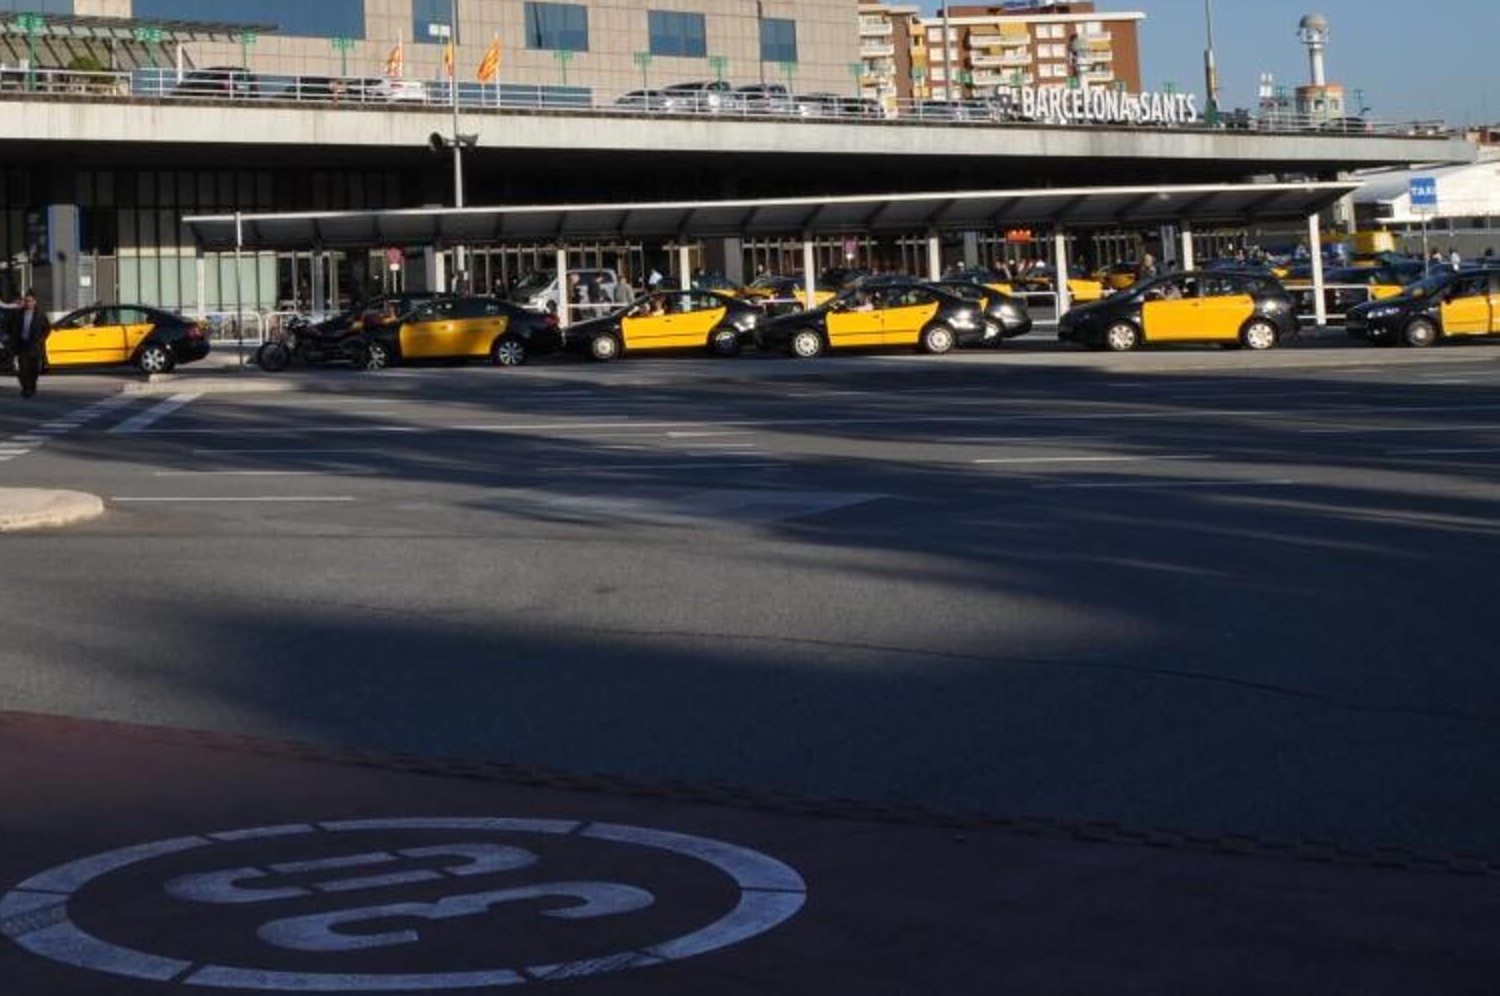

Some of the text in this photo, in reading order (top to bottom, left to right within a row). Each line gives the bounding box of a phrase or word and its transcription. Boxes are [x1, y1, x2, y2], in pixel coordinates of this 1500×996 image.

[1021, 85, 1197, 123] BARCELONA SANTS
[162, 842, 656, 952] 30
